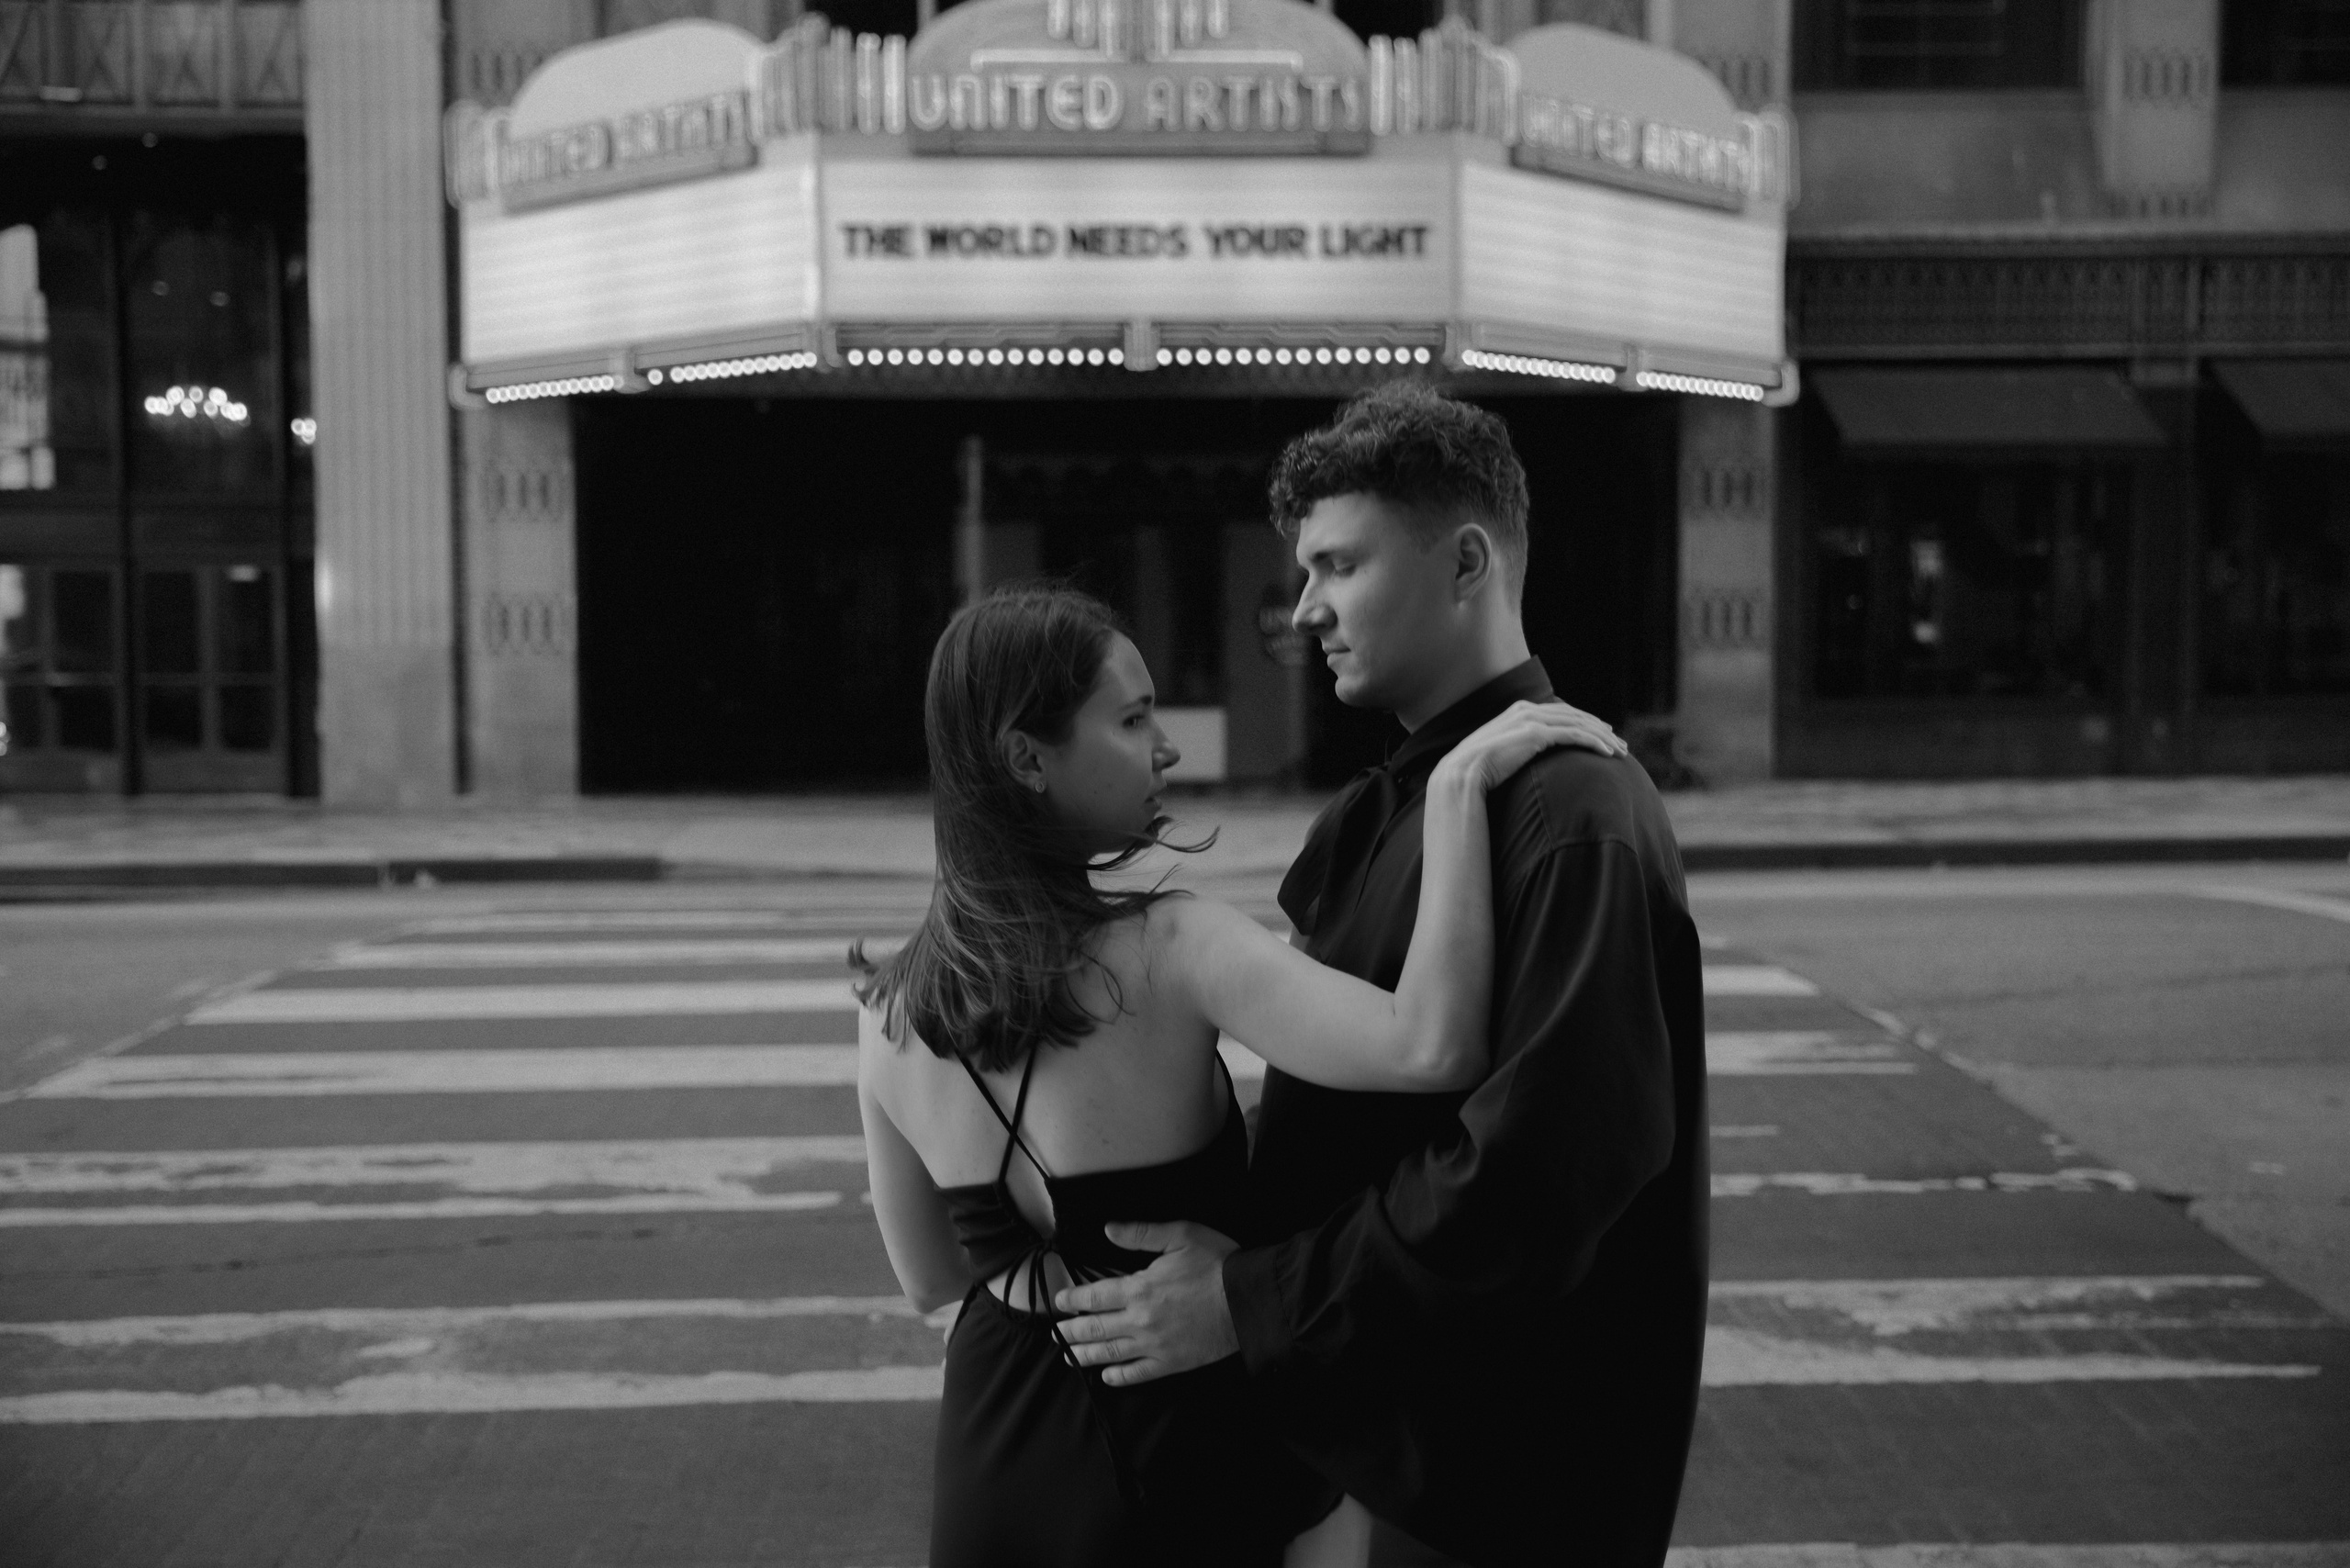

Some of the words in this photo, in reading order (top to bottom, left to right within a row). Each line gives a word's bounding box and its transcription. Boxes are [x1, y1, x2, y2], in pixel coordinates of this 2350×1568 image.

[908, 73, 1125, 131] UNITED
[1144, 74, 1362, 131] ARTISTS
[844, 225, 911, 258] THE
[929, 225, 1057, 258] WORLD
[1068, 224, 1188, 259] NEEDS
[1207, 225, 1305, 258] YOUR
[1323, 225, 1428, 258] LIGHT
